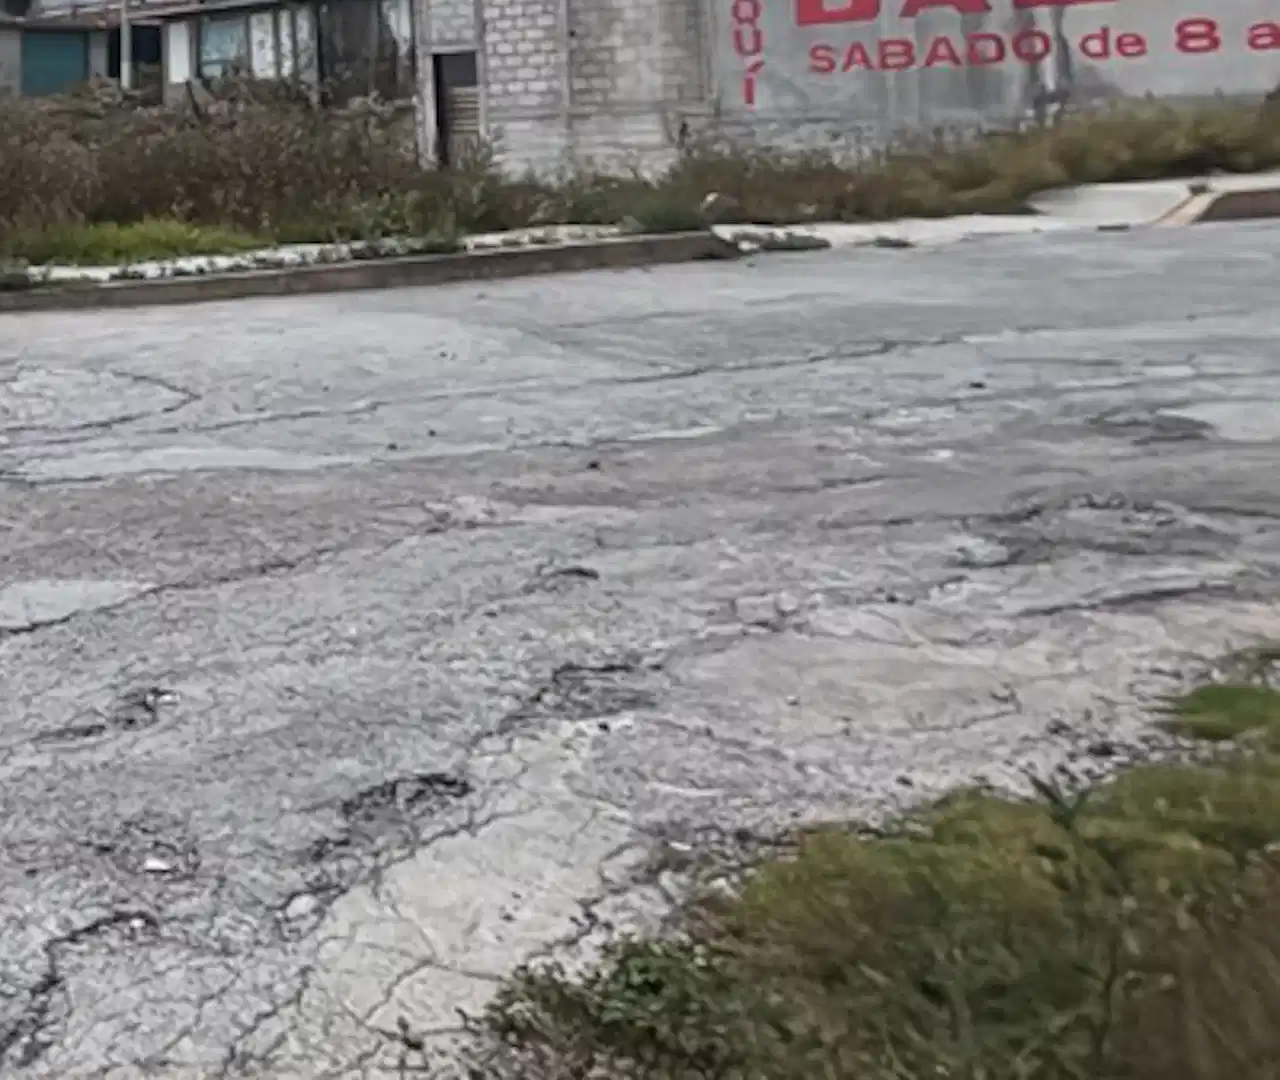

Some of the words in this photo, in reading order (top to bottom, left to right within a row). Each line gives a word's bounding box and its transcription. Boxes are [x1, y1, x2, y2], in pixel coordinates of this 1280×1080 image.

[809, 29, 1052, 74] SABADO
[1079, 24, 1148, 60] de
[1174, 18, 1222, 54] 8
